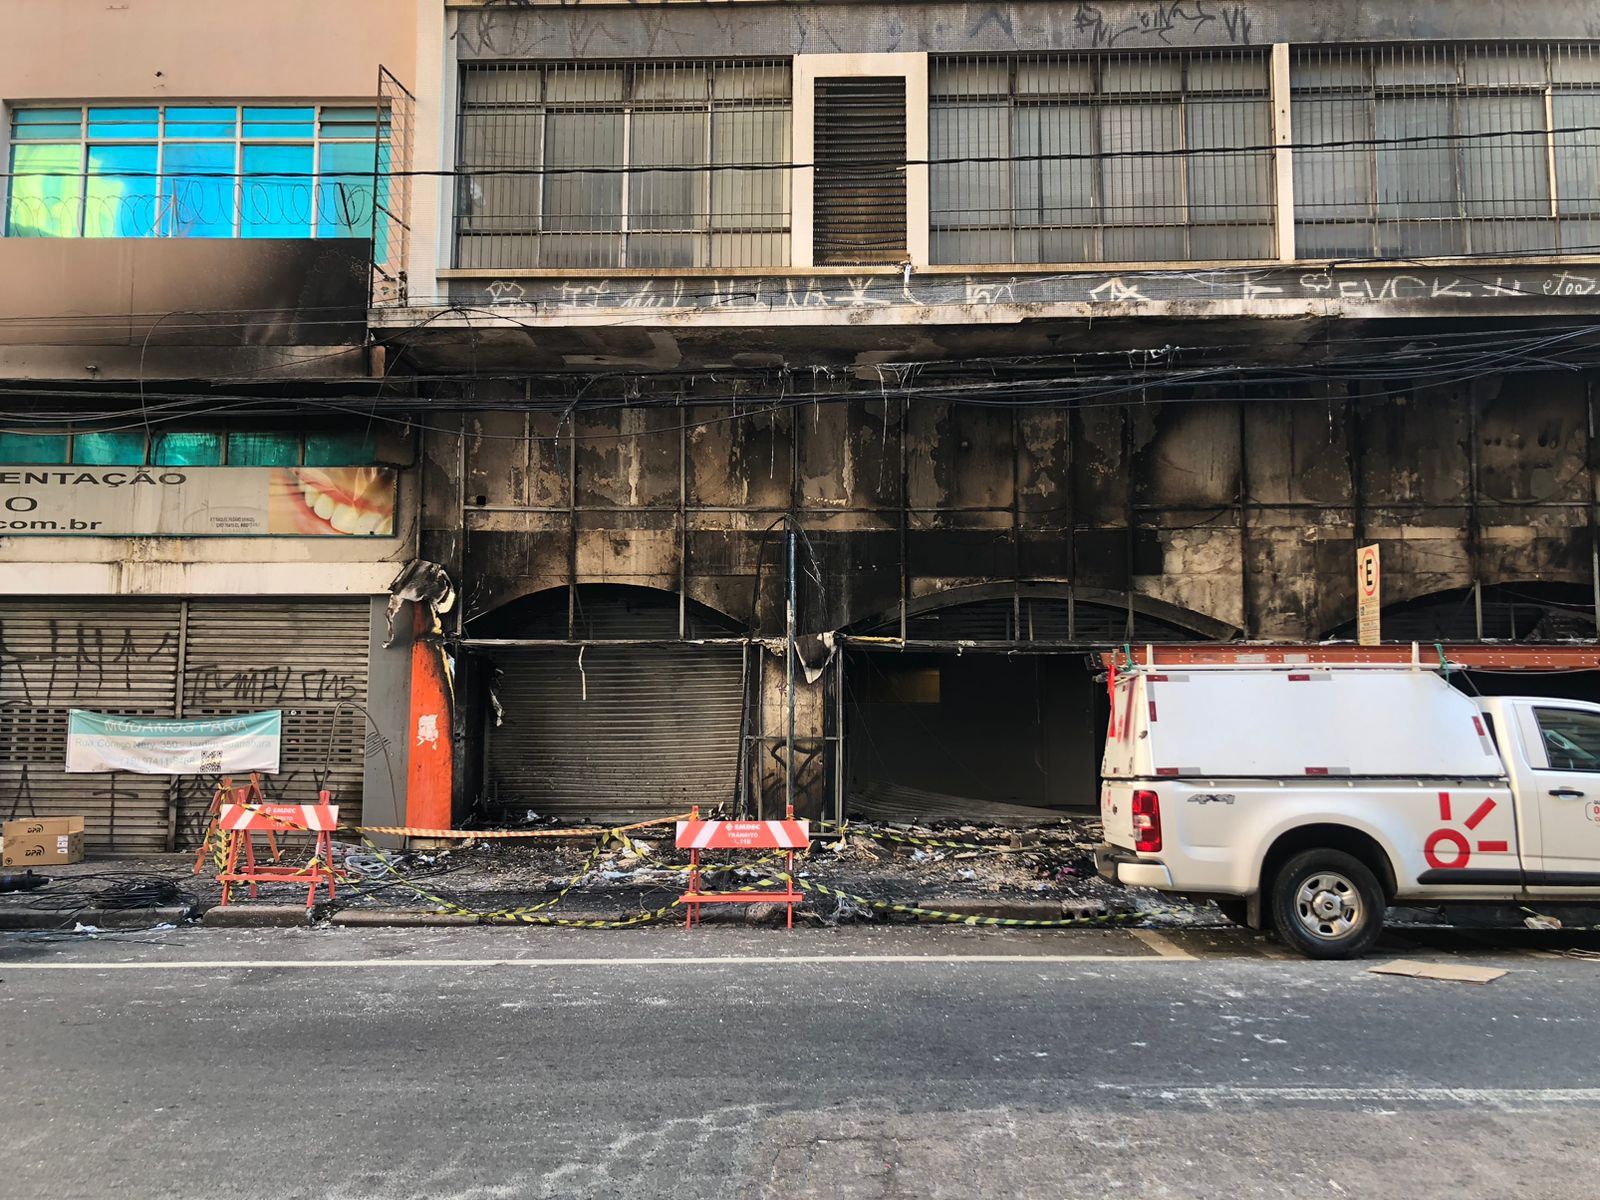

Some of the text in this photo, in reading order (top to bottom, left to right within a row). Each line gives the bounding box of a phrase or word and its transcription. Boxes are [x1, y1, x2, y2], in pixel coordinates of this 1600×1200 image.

[0, 470, 187, 488] ENTAÇÃO
[5, 496, 38, 512] O
[1366, 559, 1373, 586] E
[104, 720, 248, 733] MUDAMOS PARA
[25, 848, 43, 857] DPR
